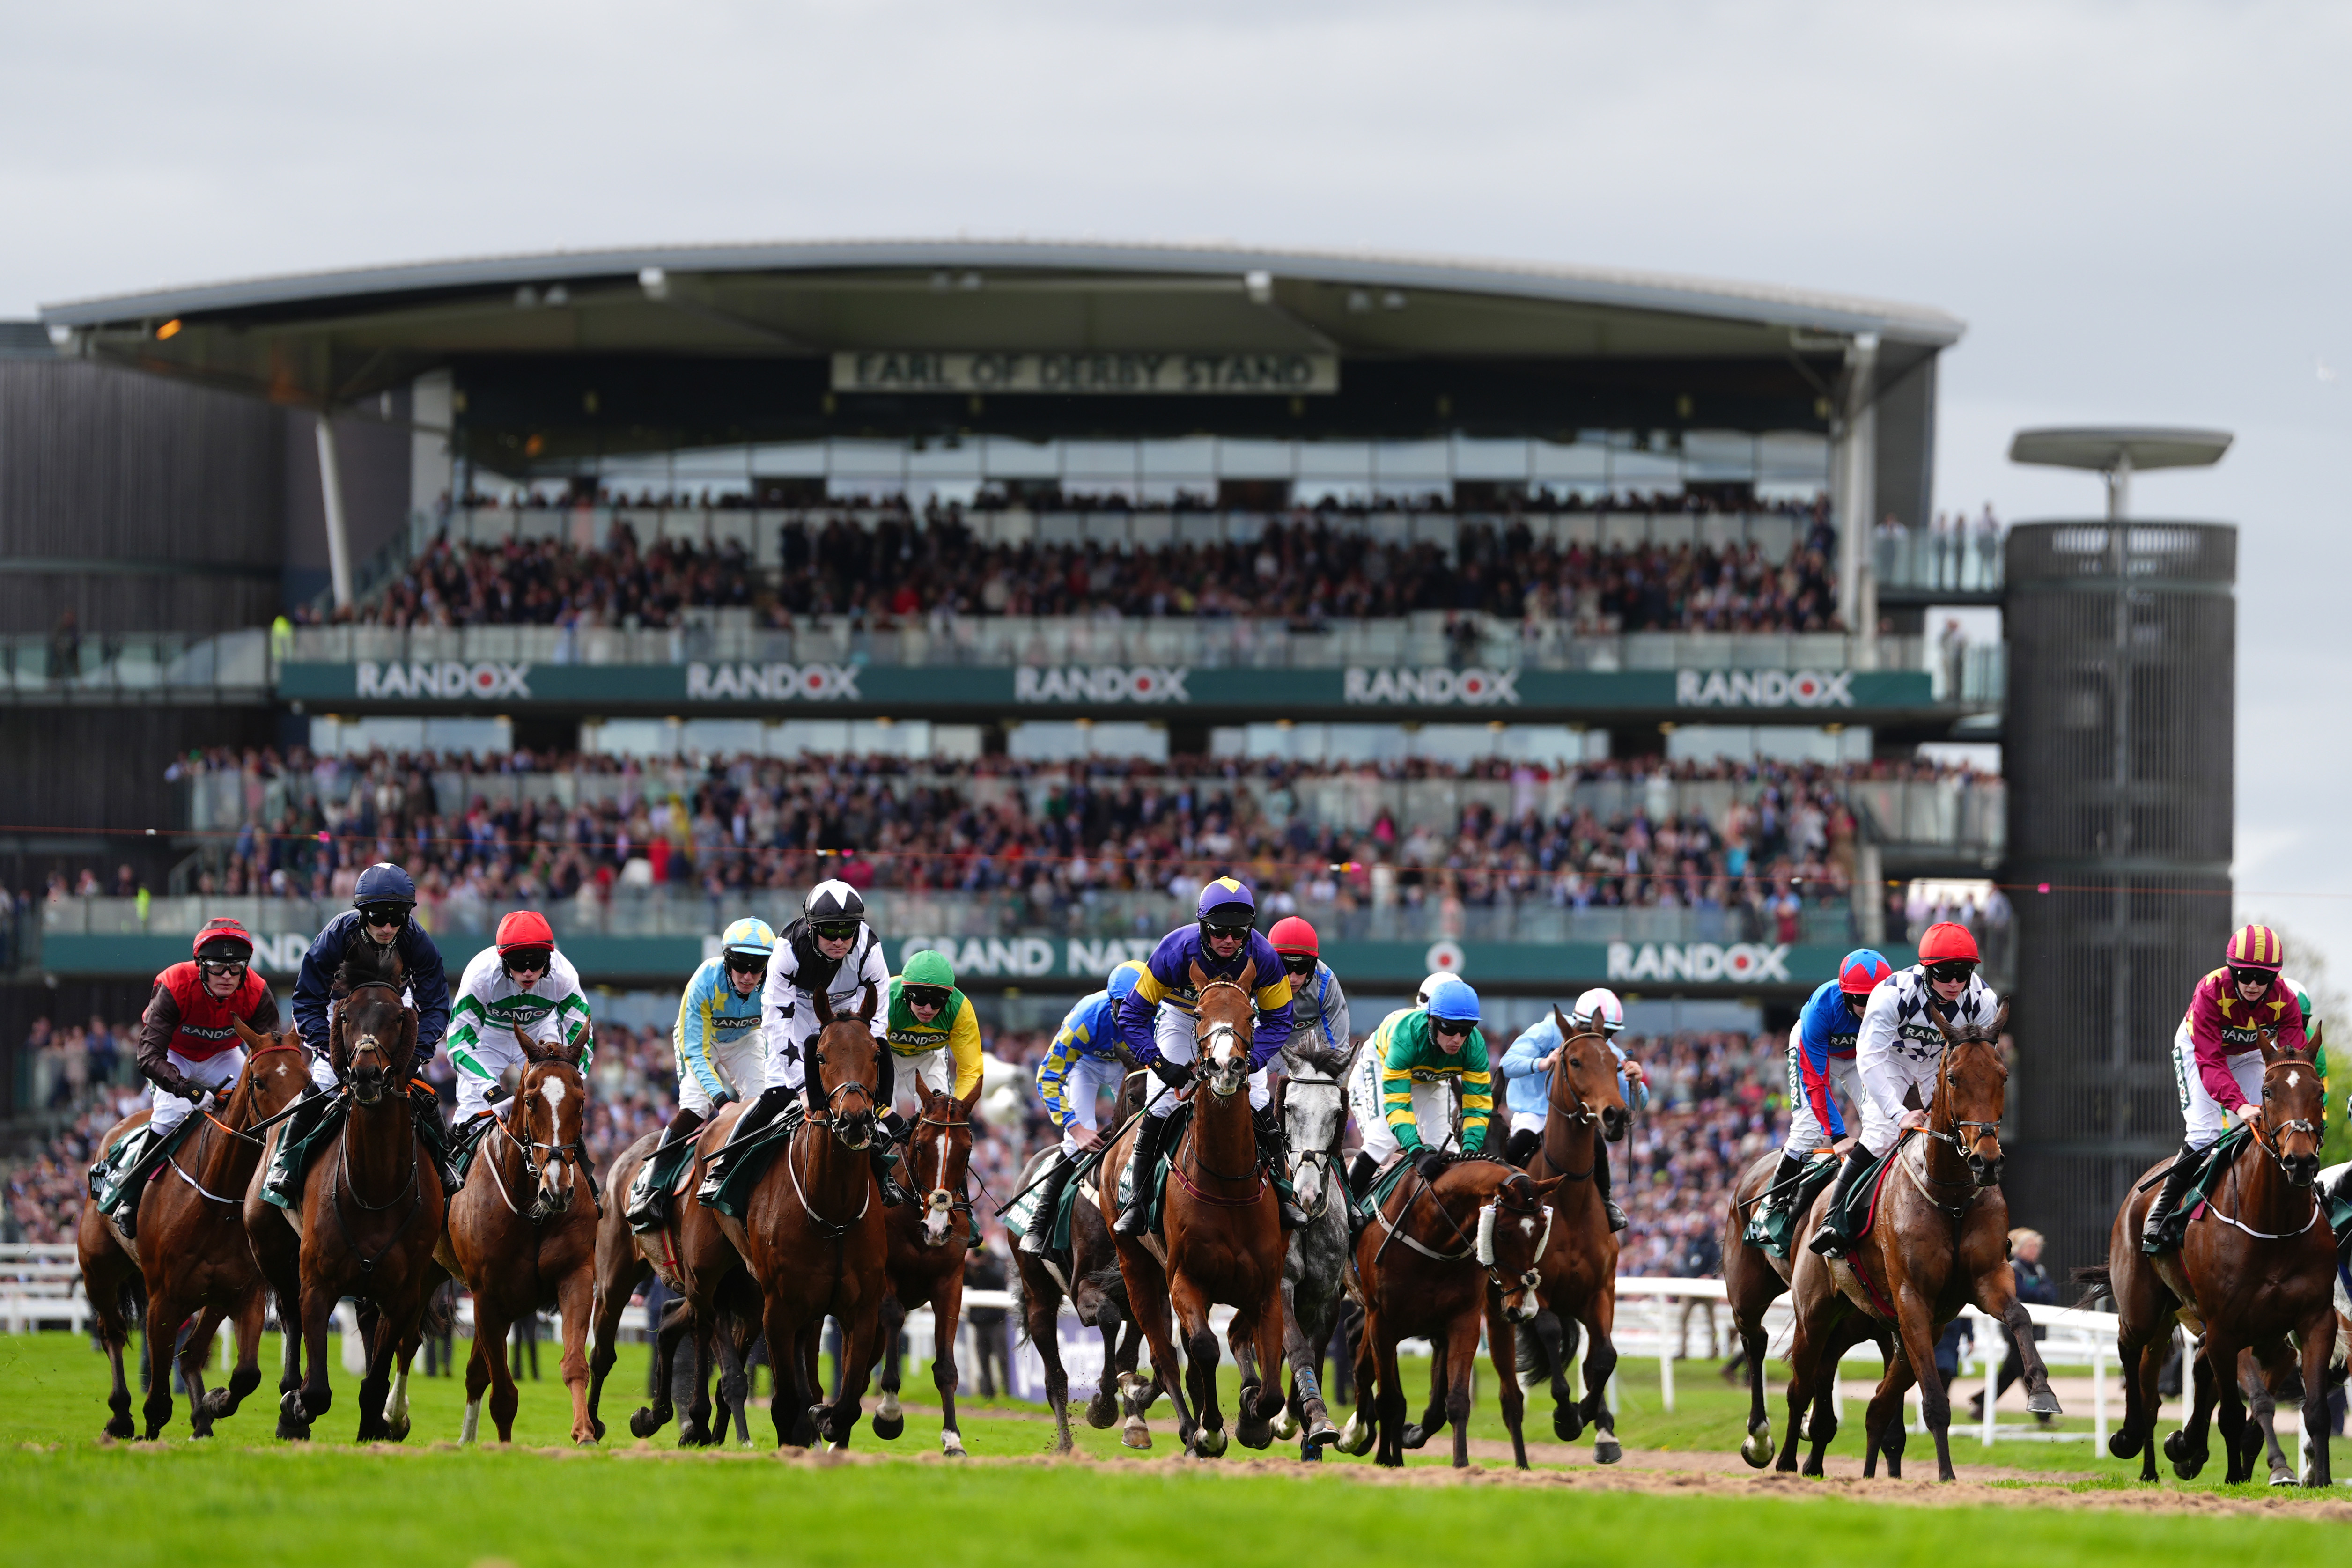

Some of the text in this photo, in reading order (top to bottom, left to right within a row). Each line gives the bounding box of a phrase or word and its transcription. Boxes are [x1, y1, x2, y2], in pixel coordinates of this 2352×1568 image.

[856, 354, 1313, 386] EARL OF DERBY STAND
[357, 662, 529, 697] RANDOX
[687, 663, 859, 698] RANDOX
[1016, 665, 1187, 700] RANDOX
[1345, 666, 1519, 703] RANDOX
[1676, 668, 1853, 706] RANDOX
[1607, 941, 1790, 982] RANDOX
[181, 1026, 237, 1039] RANDO
[711, 1017, 761, 1027] RANDO
[889, 1032, 949, 1045] RANDOX
[1905, 1026, 1946, 1042] RAN
[1831, 1036, 1858, 1045] RAN
[1363, 1061, 1376, 1119] RANDOX
[1788, 1048, 1799, 1110] RANDOX
[2173, 1048, 2189, 1108] RANDOX
